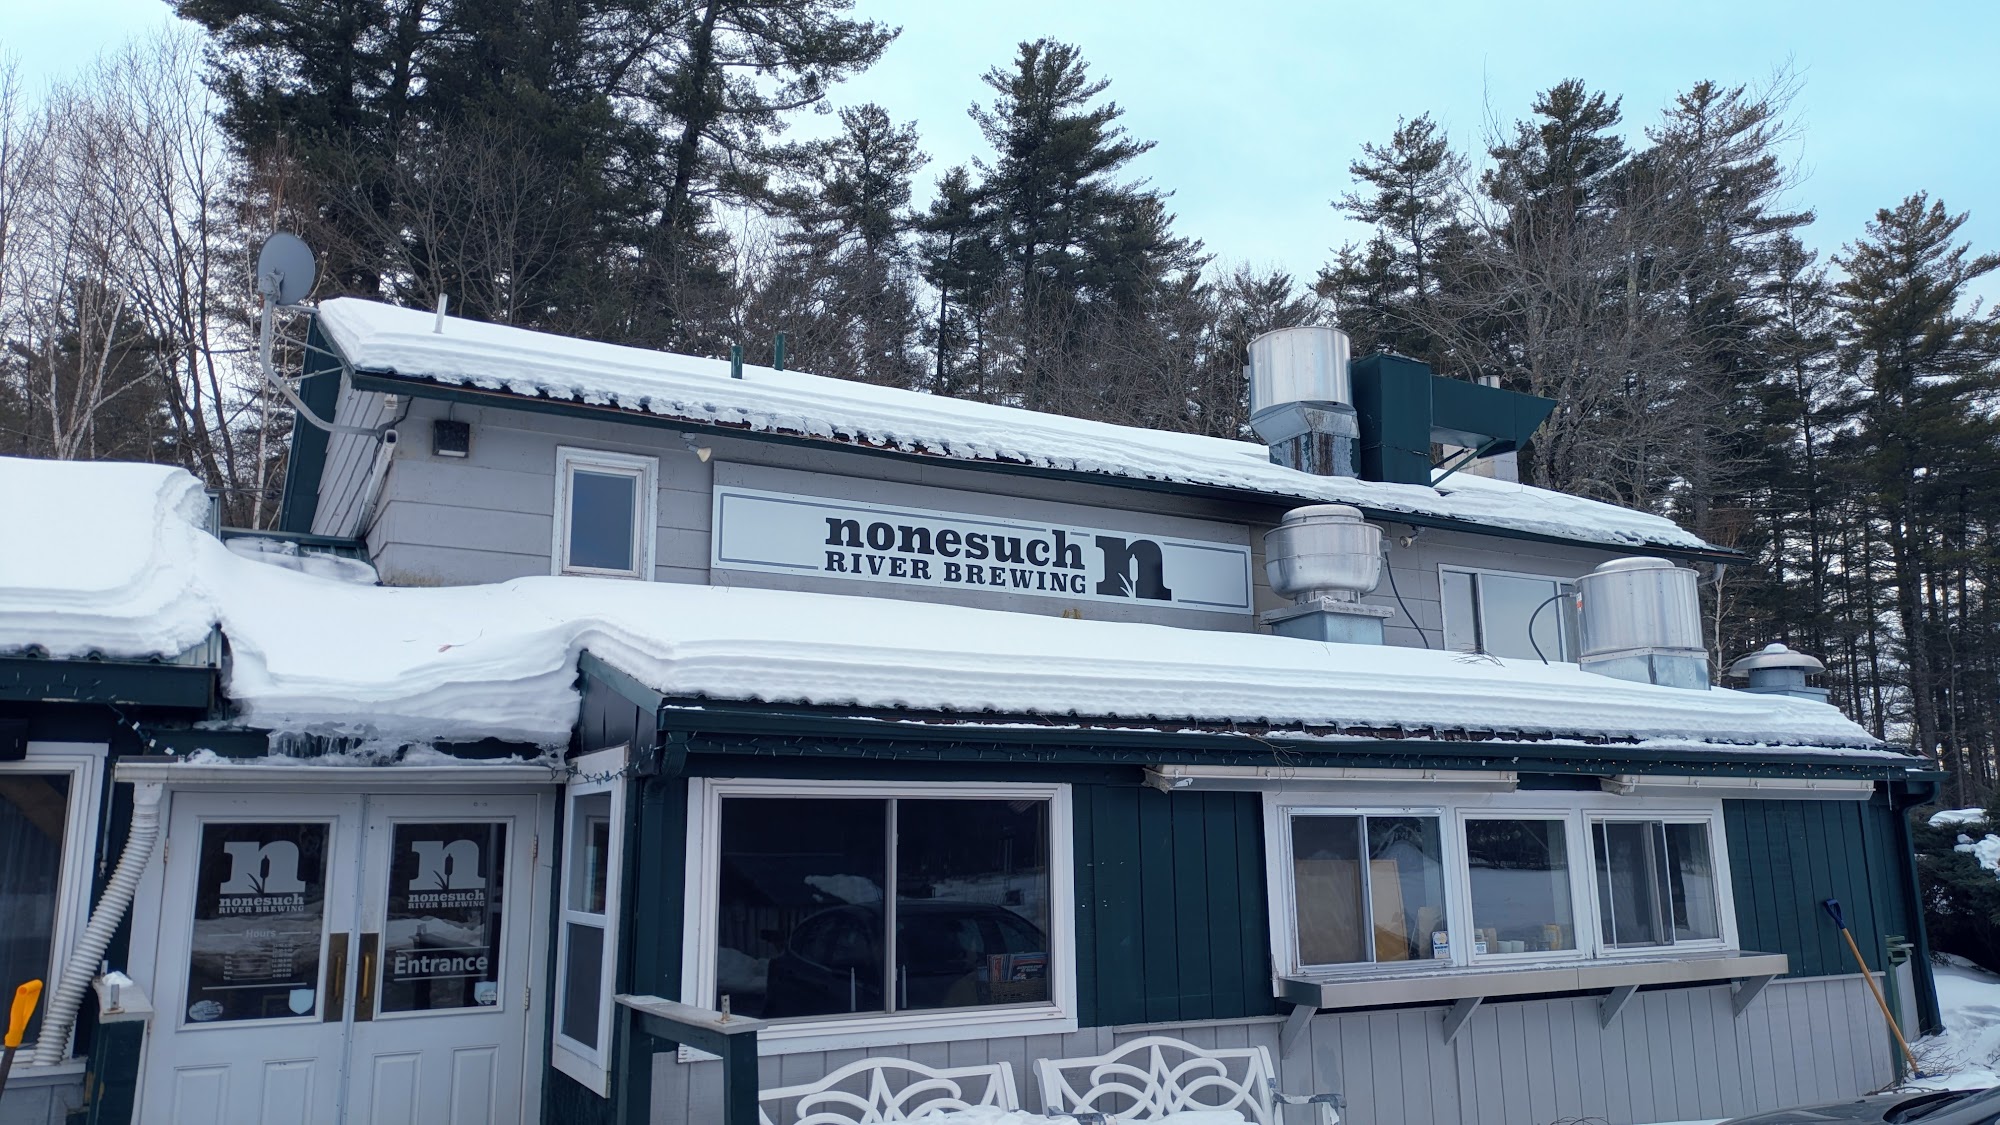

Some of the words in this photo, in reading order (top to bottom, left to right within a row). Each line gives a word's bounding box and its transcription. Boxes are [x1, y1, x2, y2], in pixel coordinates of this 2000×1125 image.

[825, 516, 1086, 571] nonesuch
[824, 550, 932, 580] RIVER
[943, 561, 1087, 594] BREWING
[218, 893, 304, 907] nonesuch
[408, 889, 485, 903] nonesuch
[218, 906, 252, 914] RIVER
[255, 905, 304, 913] BREWING
[441, 900, 485, 908] BREWING
[246, 929, 276, 938] Hours
[394, 955, 488, 975] Entrance
